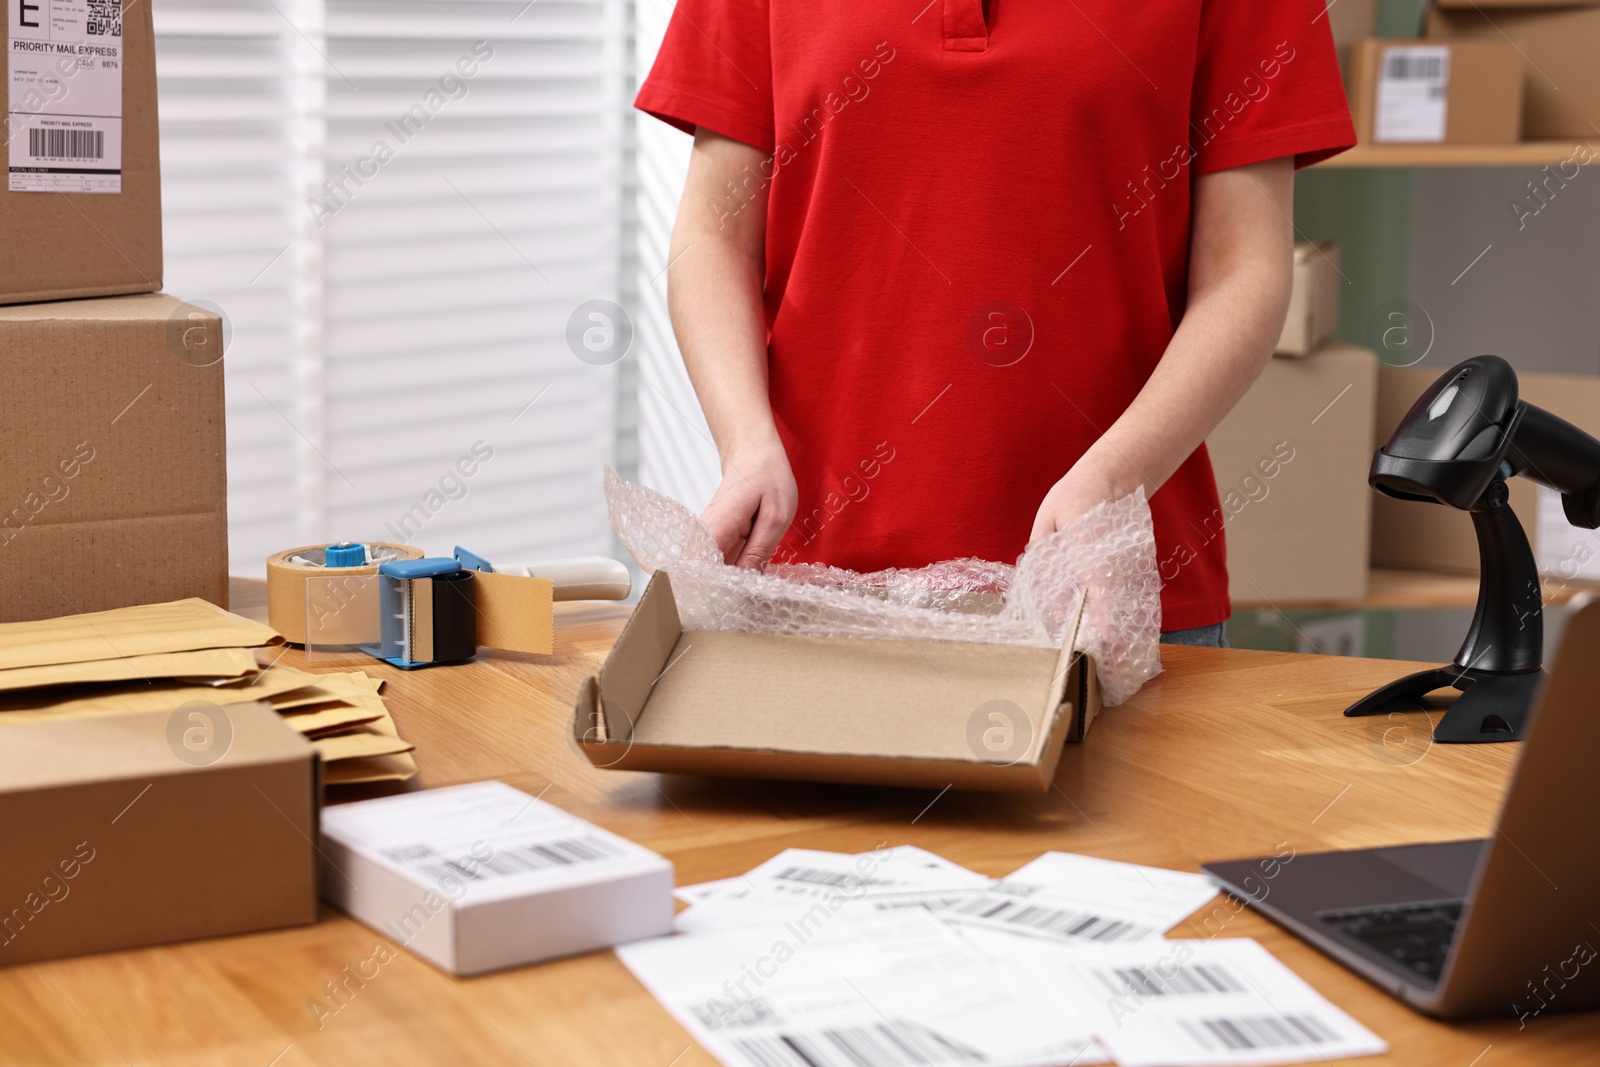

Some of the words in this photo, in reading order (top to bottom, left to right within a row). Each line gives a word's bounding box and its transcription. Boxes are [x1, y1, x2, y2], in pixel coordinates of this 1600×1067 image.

[13, 41, 55, 53] PRIORITY
[56, 44, 76, 54] MAIL
[78, 45, 117, 57] EXPRESS
